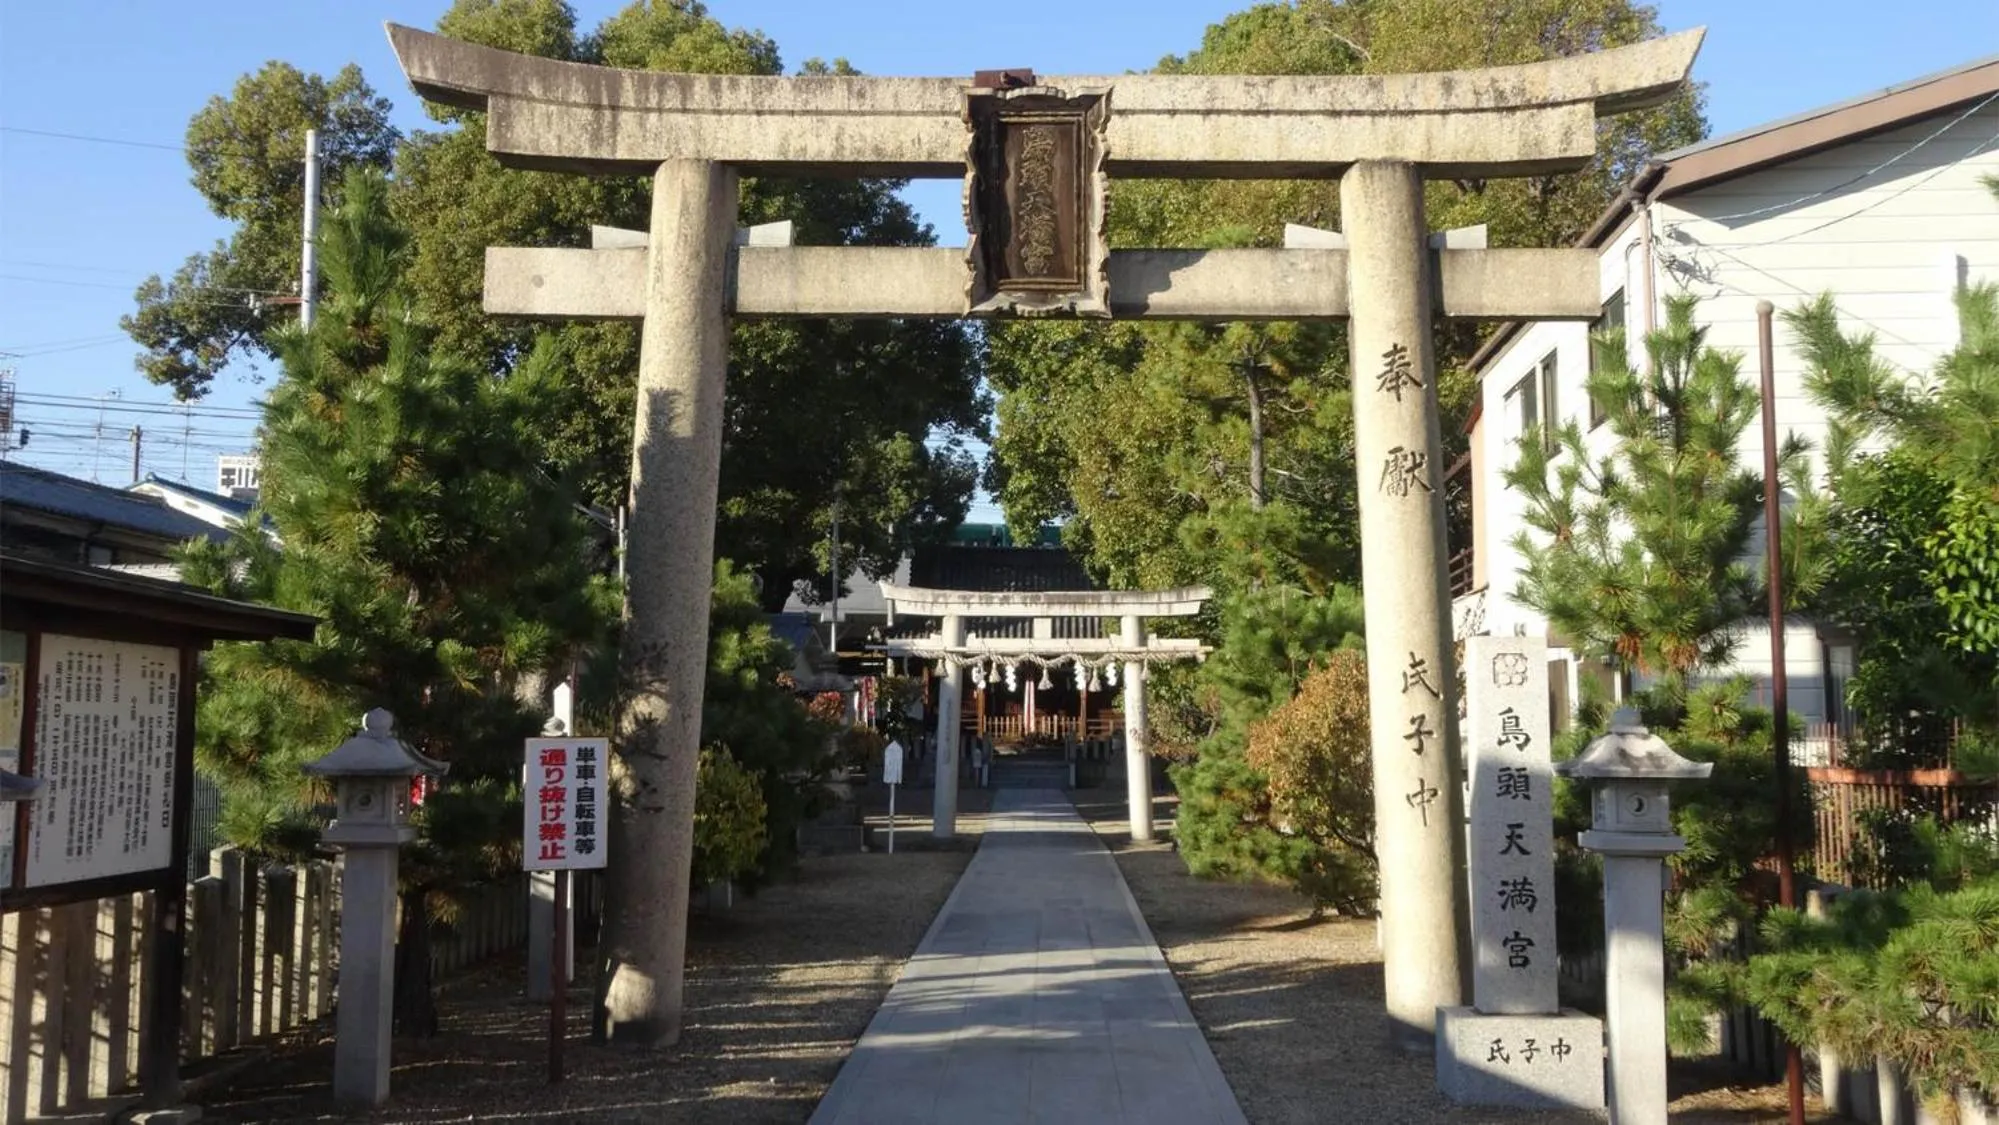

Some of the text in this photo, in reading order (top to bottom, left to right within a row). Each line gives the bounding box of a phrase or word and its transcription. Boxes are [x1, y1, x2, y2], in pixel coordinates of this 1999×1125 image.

[538, 748, 567, 860] 通り抜け禁止
[1401, 650, 1443, 827] 氏子中
[1496, 706, 1537, 969] 島頭天満宮
[1487, 1036, 1573, 1065] 氏子中
